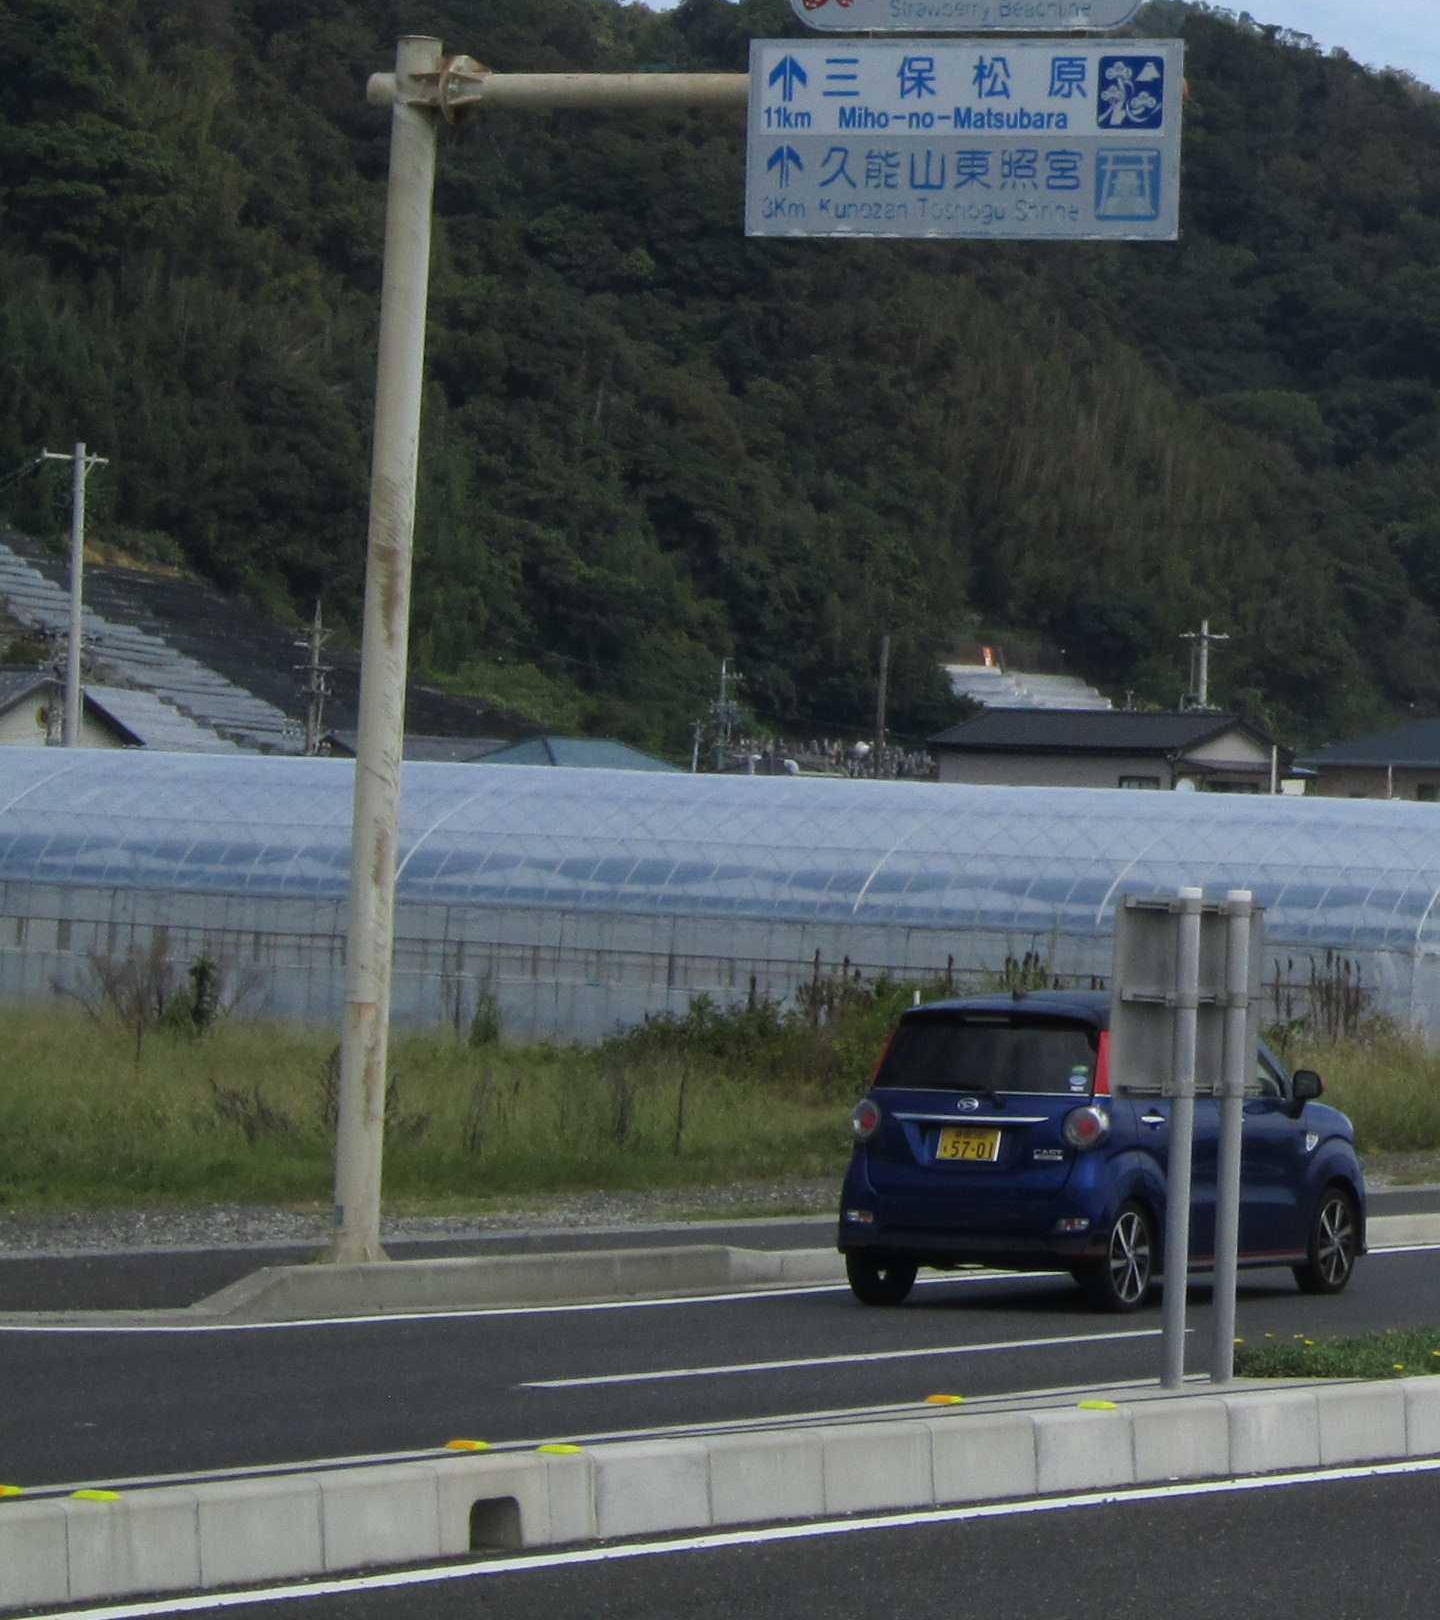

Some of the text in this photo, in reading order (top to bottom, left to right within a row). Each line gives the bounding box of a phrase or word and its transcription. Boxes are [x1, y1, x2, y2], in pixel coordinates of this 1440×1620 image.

[822, 55, 1088, 99] 三保松原
[764, 107, 1068, 130] 11km Miho-no-Matsubara
[819, 146, 1083, 191] 久能山東照宮
[951, 1141, 994, 1158] 57-01
